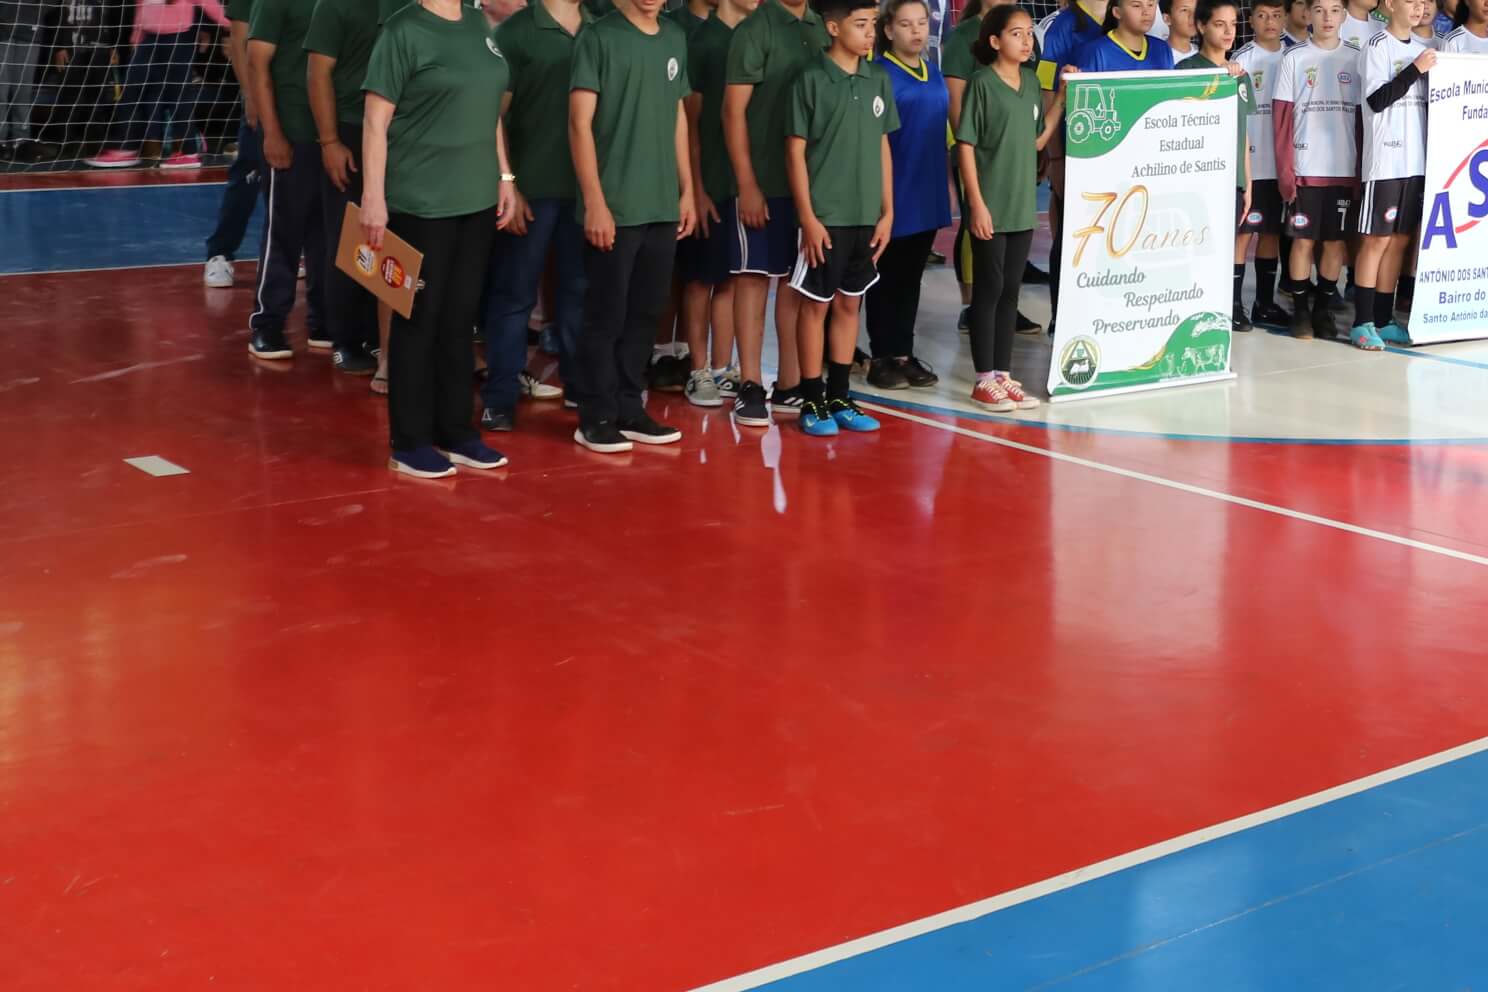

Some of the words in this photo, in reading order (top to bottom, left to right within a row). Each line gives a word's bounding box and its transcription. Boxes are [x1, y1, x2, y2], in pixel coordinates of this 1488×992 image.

[1430, 82, 1461, 104] Escola
[1144, 114, 1178, 129] Escola
[1180, 112, 1221, 128] Técnica
[1159, 135, 1205, 152] Estadual
[1131, 162, 1178, 178] Achilino
[1179, 160, 1193, 174] de
[1194, 157, 1226, 173] Santis
[1072, 184, 1149, 268] 70
[1142, 223, 1210, 250] anos
[1337, 207, 1348, 231] 7
[1076, 266, 1147, 289] Cuidando
[1457, 268, 1471, 281] DOS
[1123, 282, 1204, 313] Respeitando
[1438, 290, 1472, 304] Bairro
[1474, 289, 1486, 301] do
[1092, 309, 1180, 335] Preservando
[1423, 313, 1448, 324] Santo
